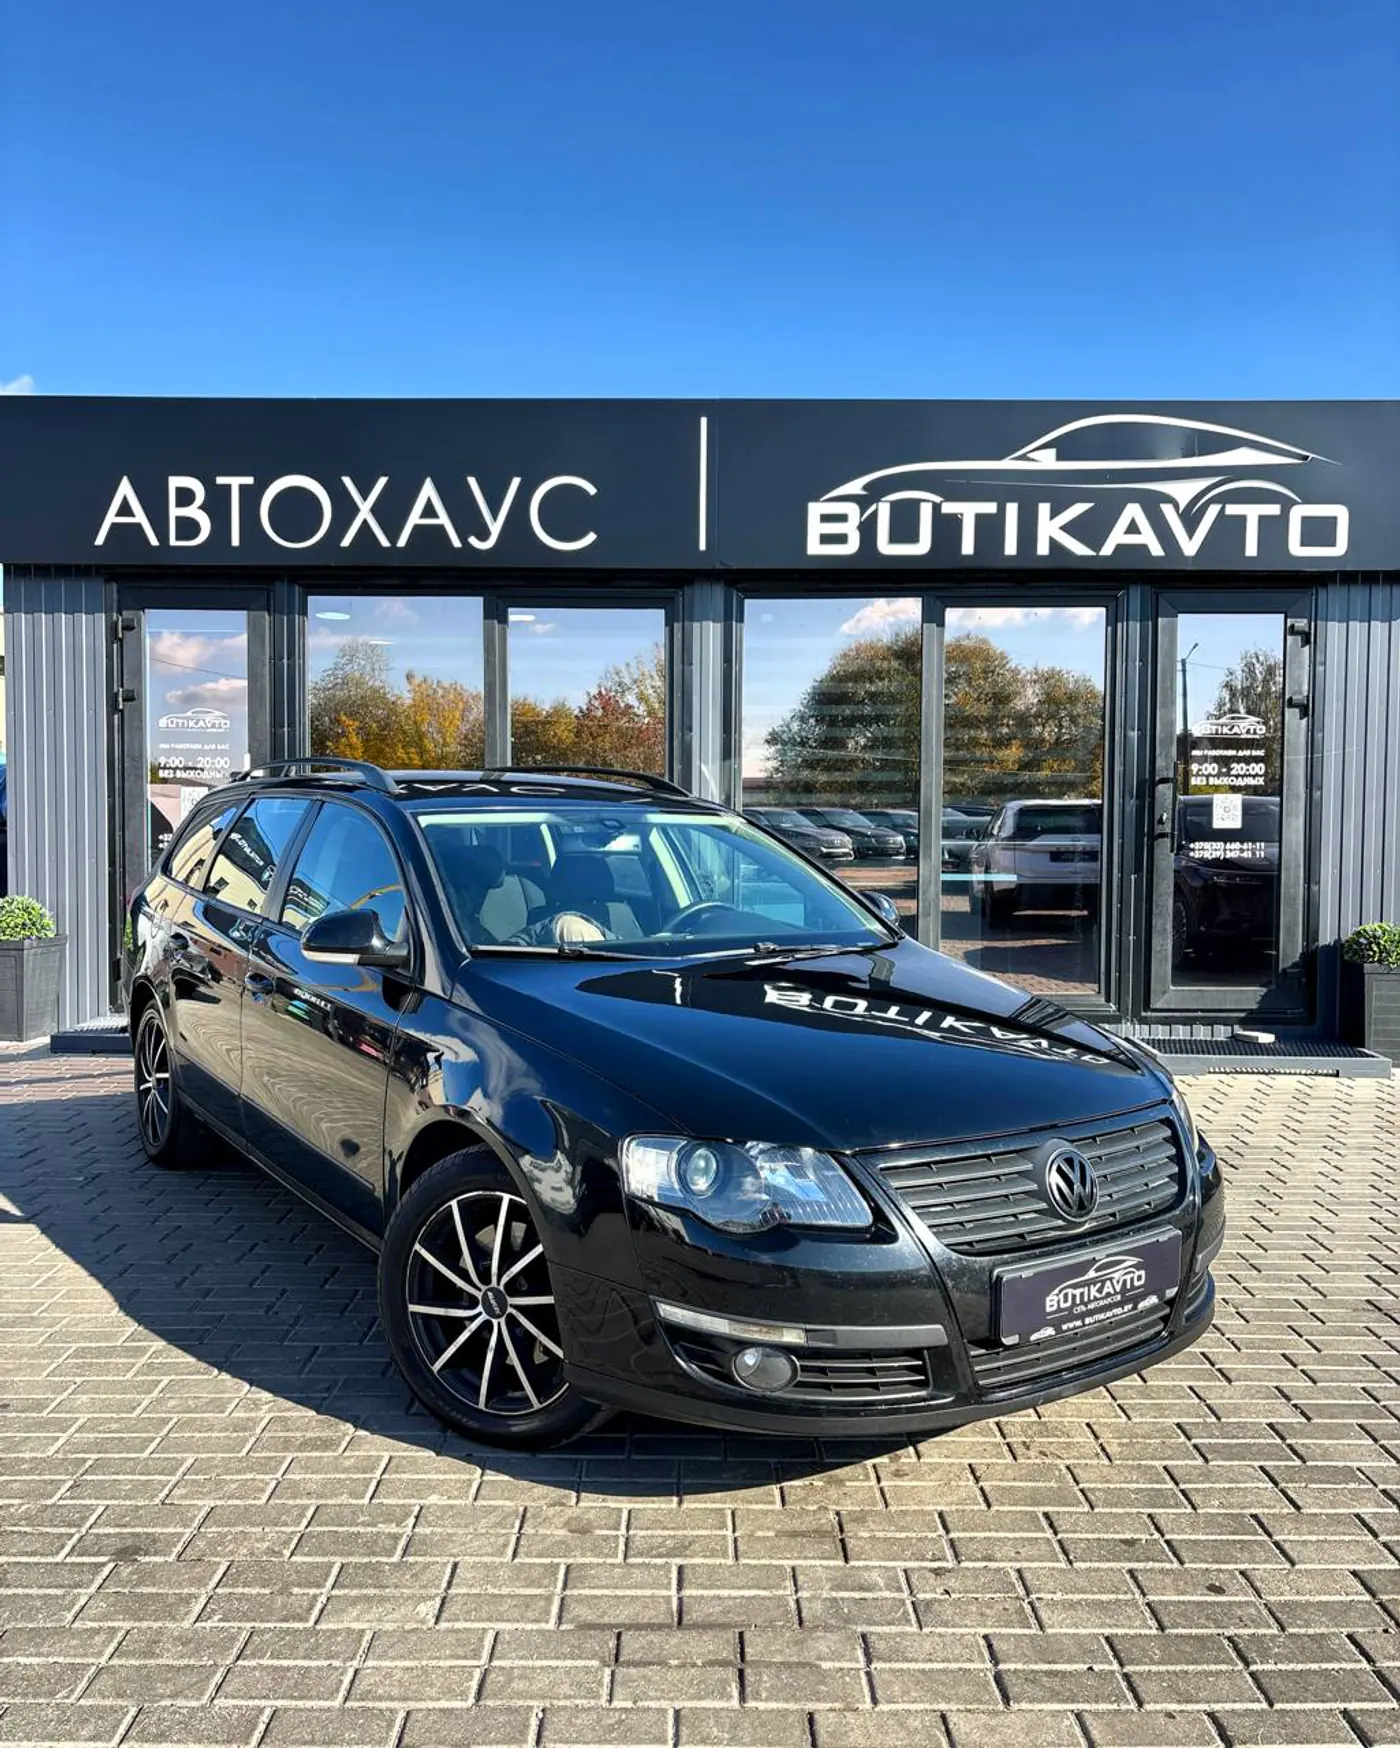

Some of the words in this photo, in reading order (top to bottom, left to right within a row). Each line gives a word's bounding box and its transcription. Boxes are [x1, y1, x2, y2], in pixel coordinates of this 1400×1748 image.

[94, 474, 598, 551] АВТОХАУС
[805, 500, 1350, 557] BUTIKAVTO
[159, 718, 230, 728] BUTIKAVTO
[159, 756, 185, 768] 9:00
[197, 756, 230, 769] 20:00
[1191, 762, 1218, 775] 9:00
[1230, 762, 1266, 775] 20:00
[1191, 776, 1207, 786] БЕЗ
[1208, 776, 1265, 787] ВЫХОДНЫХ
[1045, 1269, 1146, 1313] BUTIKAVTO
